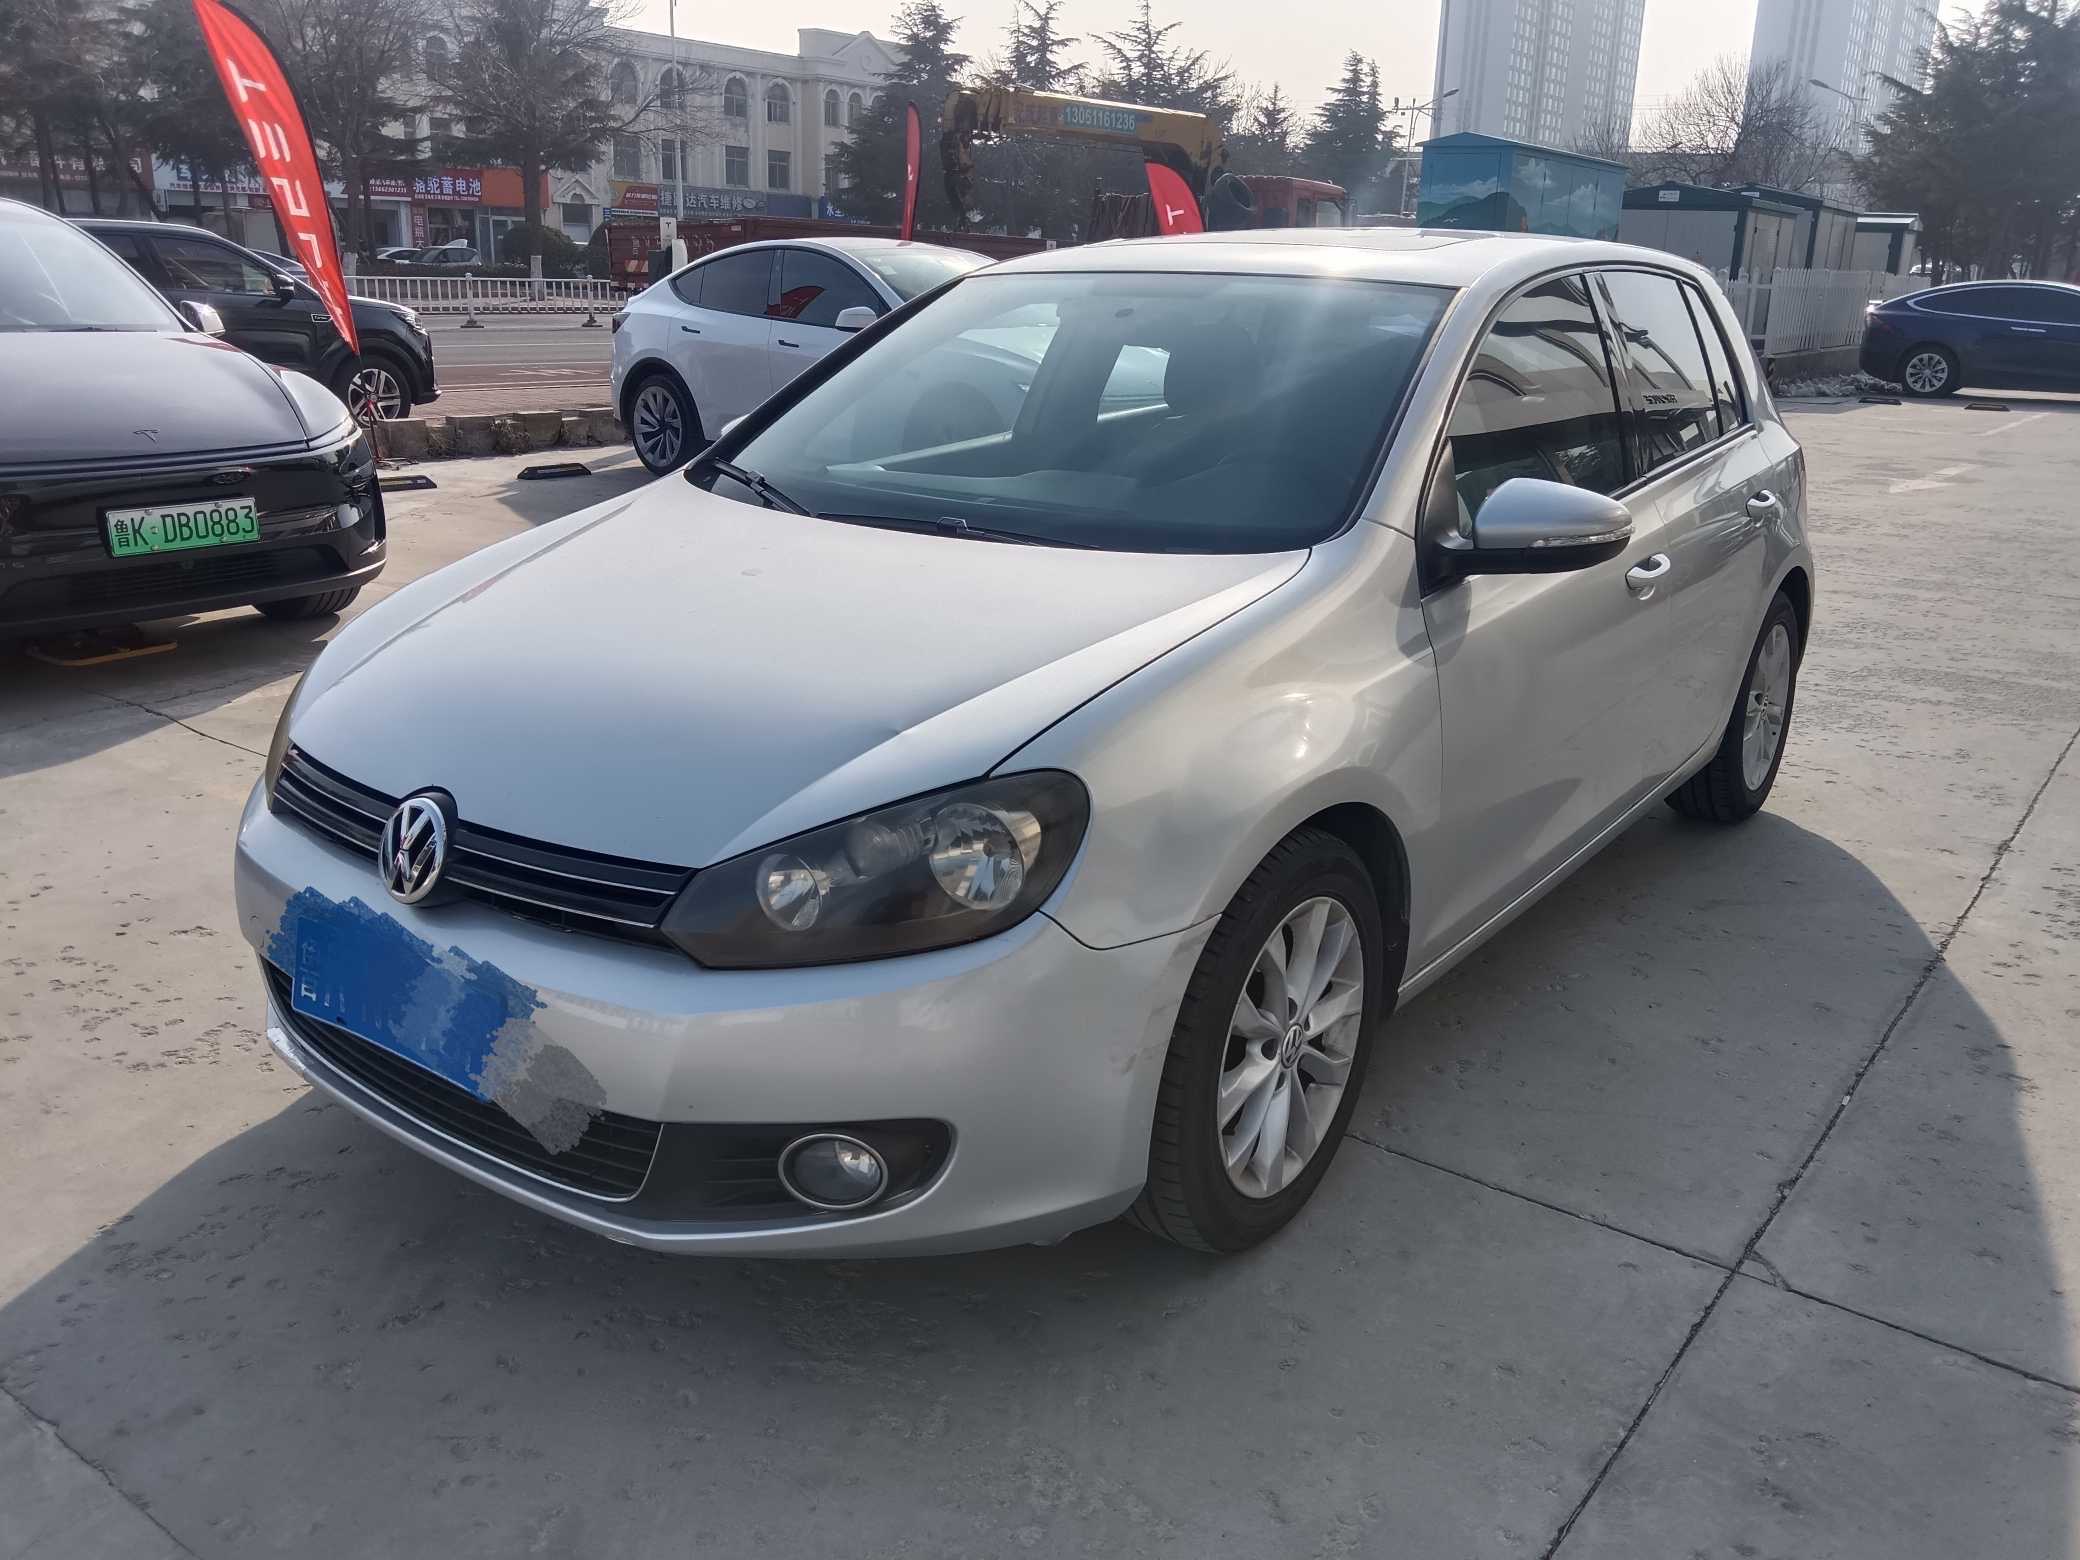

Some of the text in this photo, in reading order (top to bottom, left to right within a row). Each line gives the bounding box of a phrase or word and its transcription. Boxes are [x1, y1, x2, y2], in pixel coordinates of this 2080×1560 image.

[413, 176, 481, 195] 骆驼蓄电池
[661, 191, 742, 211] 捷达汽车维修
